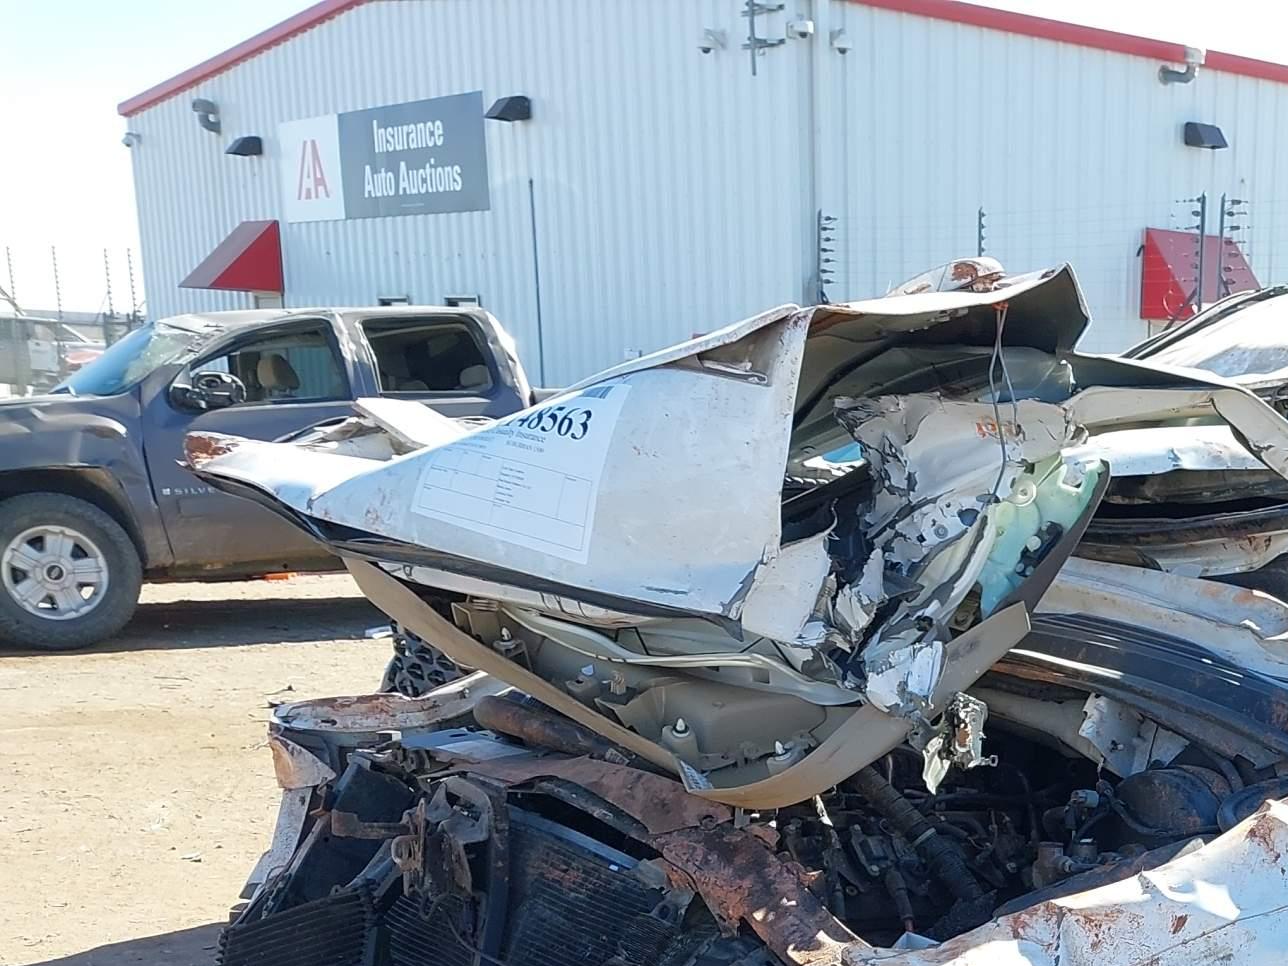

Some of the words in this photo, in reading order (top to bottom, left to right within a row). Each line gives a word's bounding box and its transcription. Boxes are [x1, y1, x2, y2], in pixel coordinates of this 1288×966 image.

[373, 119, 444, 153] Insurance
[364, 164, 395, 198] Auto
[399, 158, 463, 196] Auctions
